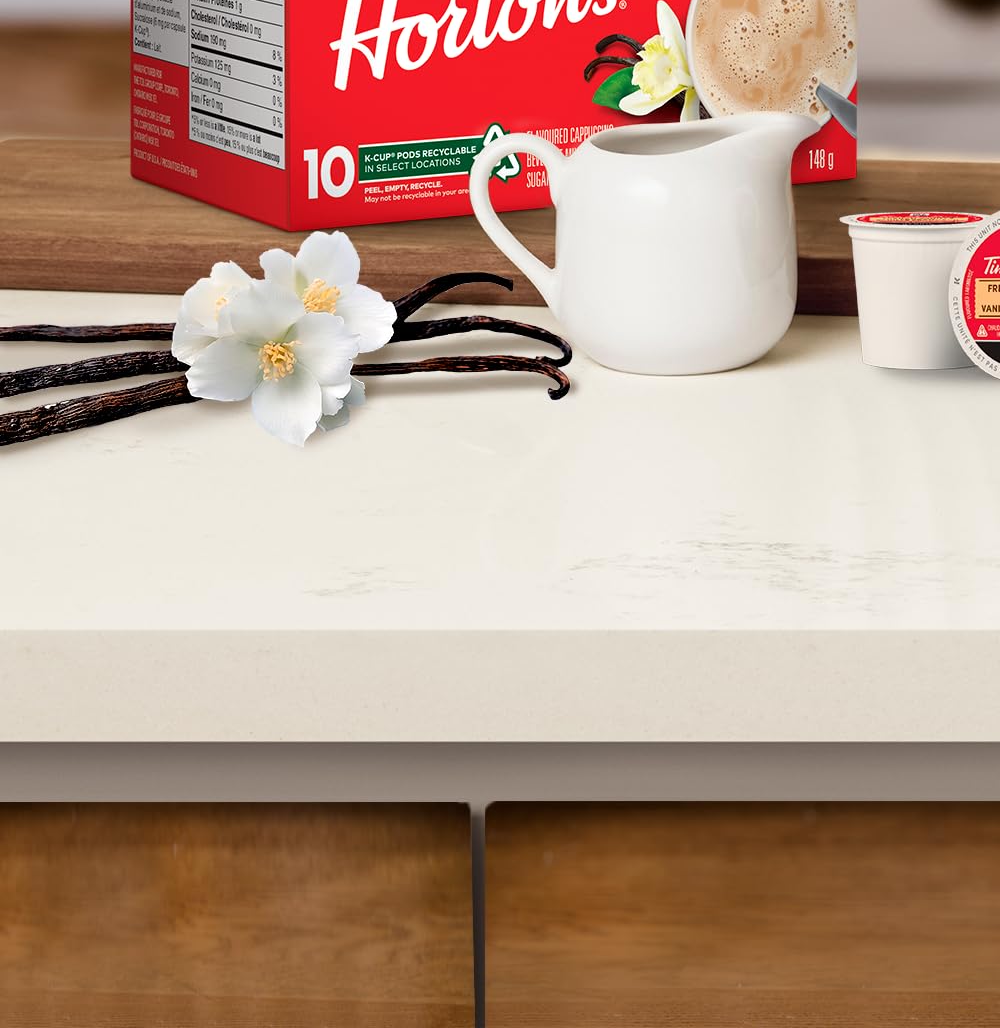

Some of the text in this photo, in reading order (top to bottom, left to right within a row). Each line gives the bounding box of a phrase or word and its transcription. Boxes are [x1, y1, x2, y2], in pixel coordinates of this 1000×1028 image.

[191, 9, 217, 25] Cholesterol
[191, 29, 209, 43] Sodium
[191, 52, 214, 69] Potassium
[191, 71, 208, 86] Calcium
[397, 150, 421, 160] PODS
[422, 146, 477, 158] RECYCLABLE
[809, 149, 834, 170] 148 g
[303, 145, 355, 199] 10
[365, 157, 461, 173] IN SELECT LOCATIONS
[364, 181, 443, 194] PEEL, EMPTY, RECYCLE.
[364, 196, 379, 204] May
[402, 190, 434, 200] recyclable
[966, 238, 979, 252] THIS
[978, 225, 992, 239] UNIT
[985, 360, 998, 372] PAS
